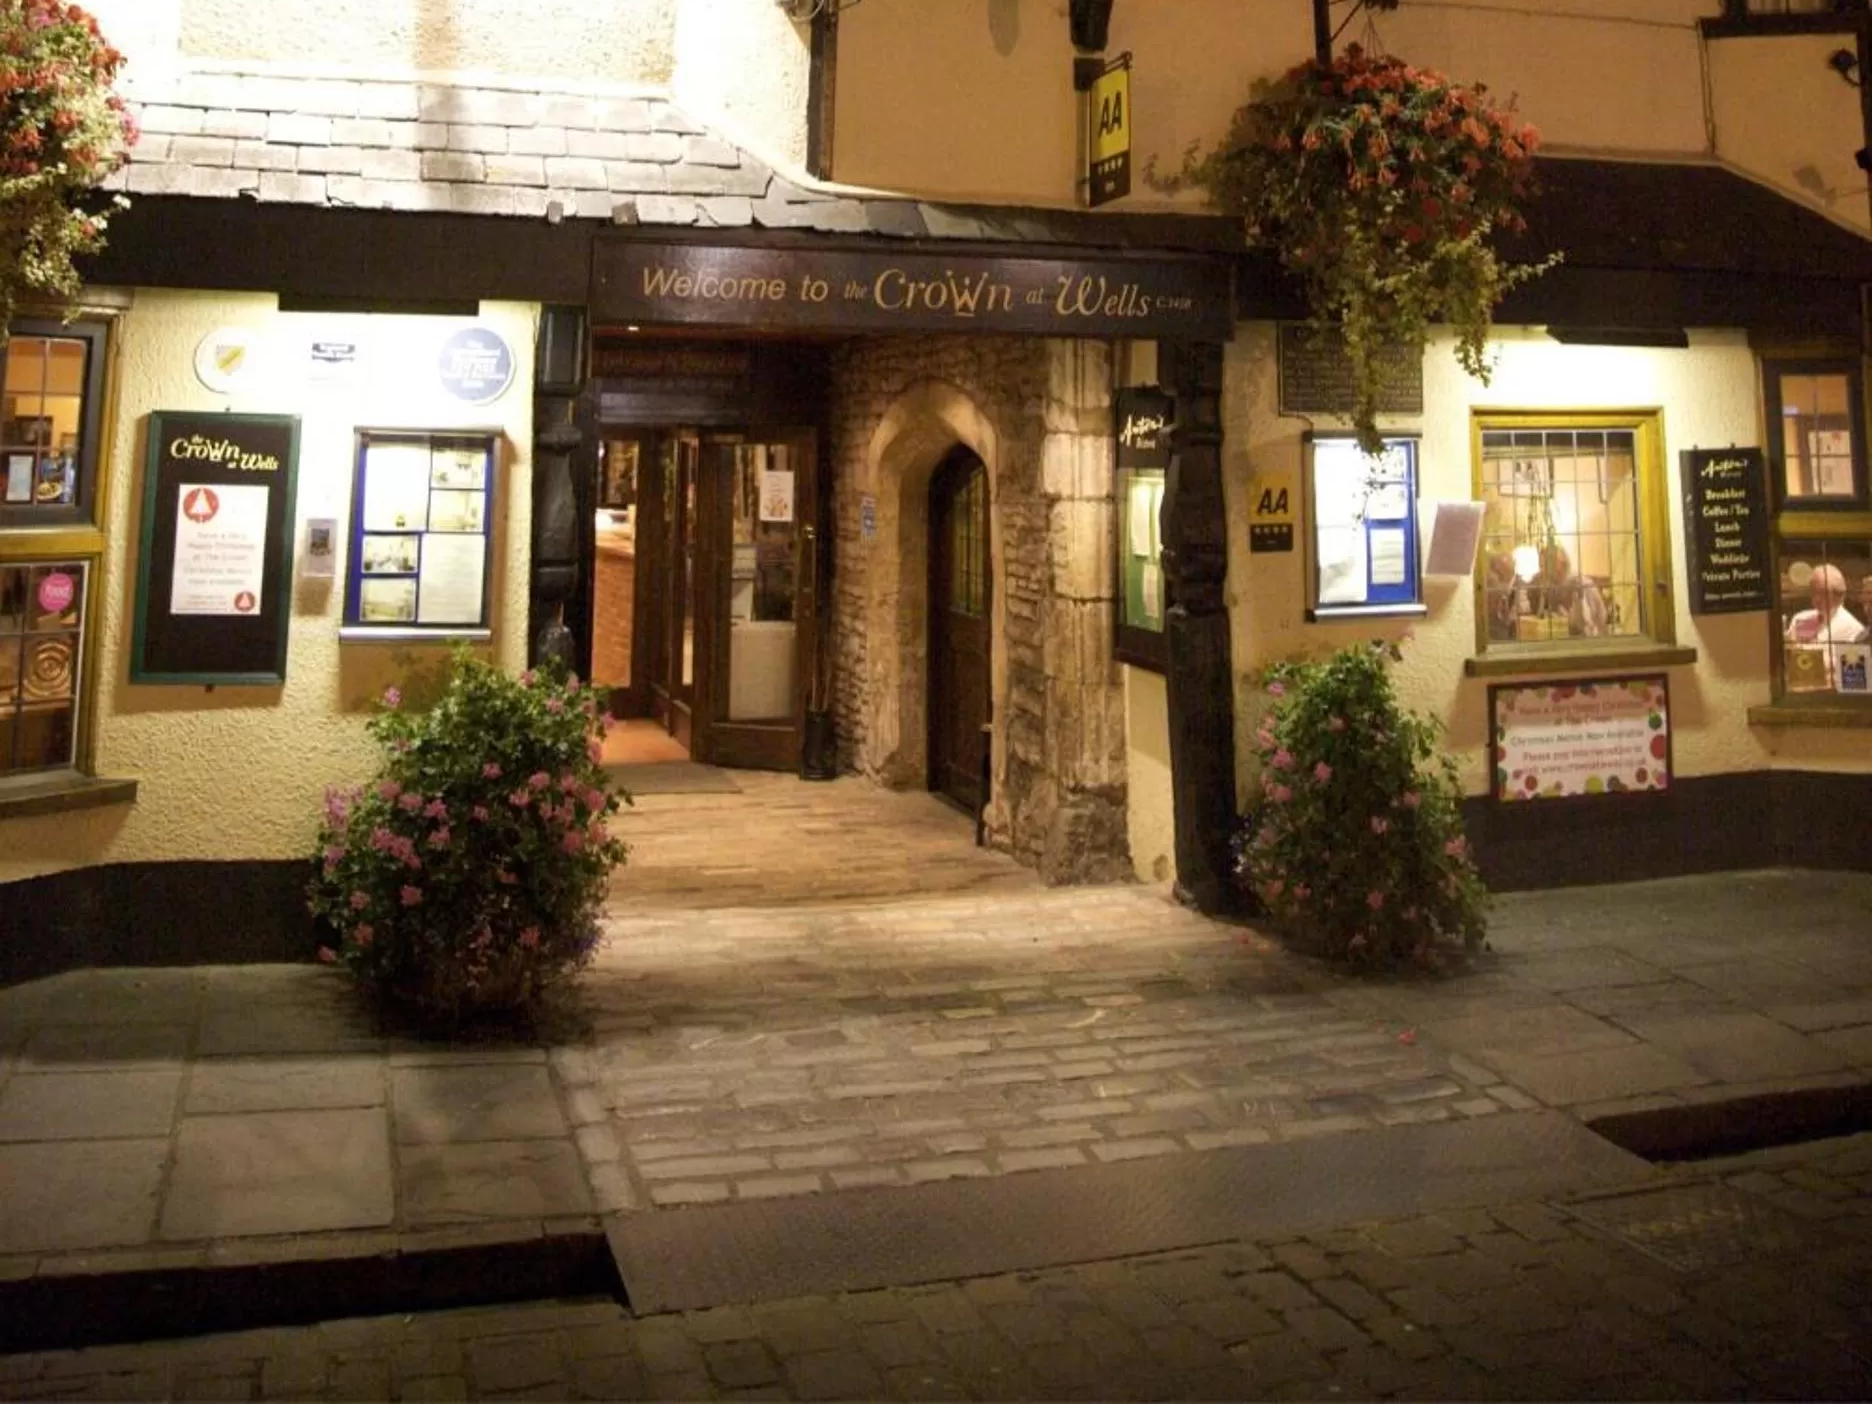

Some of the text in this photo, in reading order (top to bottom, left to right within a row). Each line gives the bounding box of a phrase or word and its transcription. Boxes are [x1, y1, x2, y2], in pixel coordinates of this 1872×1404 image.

[1098, 90, 1123, 139] AA
[642, 266, 788, 302] Welcome
[800, 273, 829, 303] to
[843, 283, 868, 300] the
[1025, 287, 1046, 305] at
[1055, 273, 1152, 318] Wells
[240, 453, 280, 471] Wells
[1256, 486, 1289, 516] AA
[1704, 486, 1746, 501] Breakfast
[1702, 504, 1729, 518] Coffee
[1714, 520, 1741, 534] Lunch
